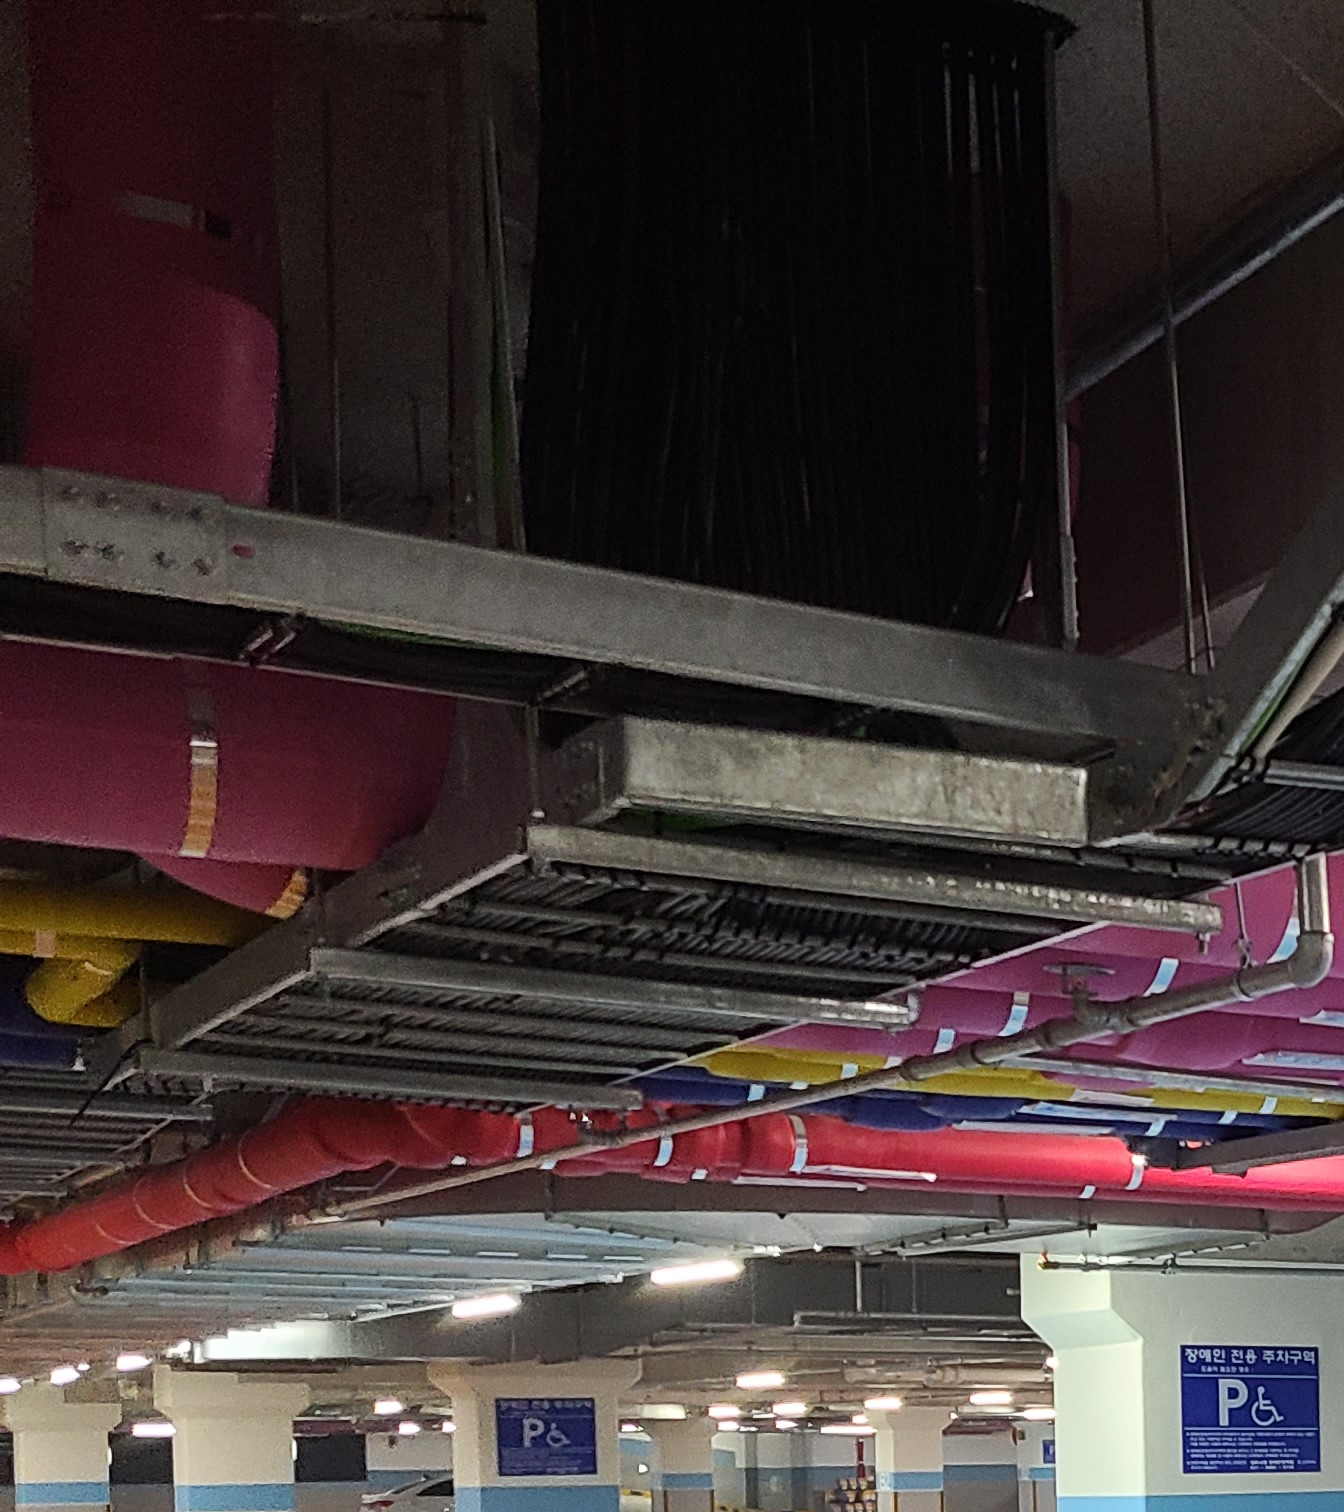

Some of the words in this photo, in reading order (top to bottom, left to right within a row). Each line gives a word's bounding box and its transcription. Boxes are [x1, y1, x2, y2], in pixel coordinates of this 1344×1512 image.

[1185, 1348, 1226, 1363] 장애인
[1231, 1349, 1257, 1364] 전용
[1262, 1350, 1315, 1365] 주차구역
[1218, 1378, 1249, 1426] P
[523, 1418, 545, 1447] P
